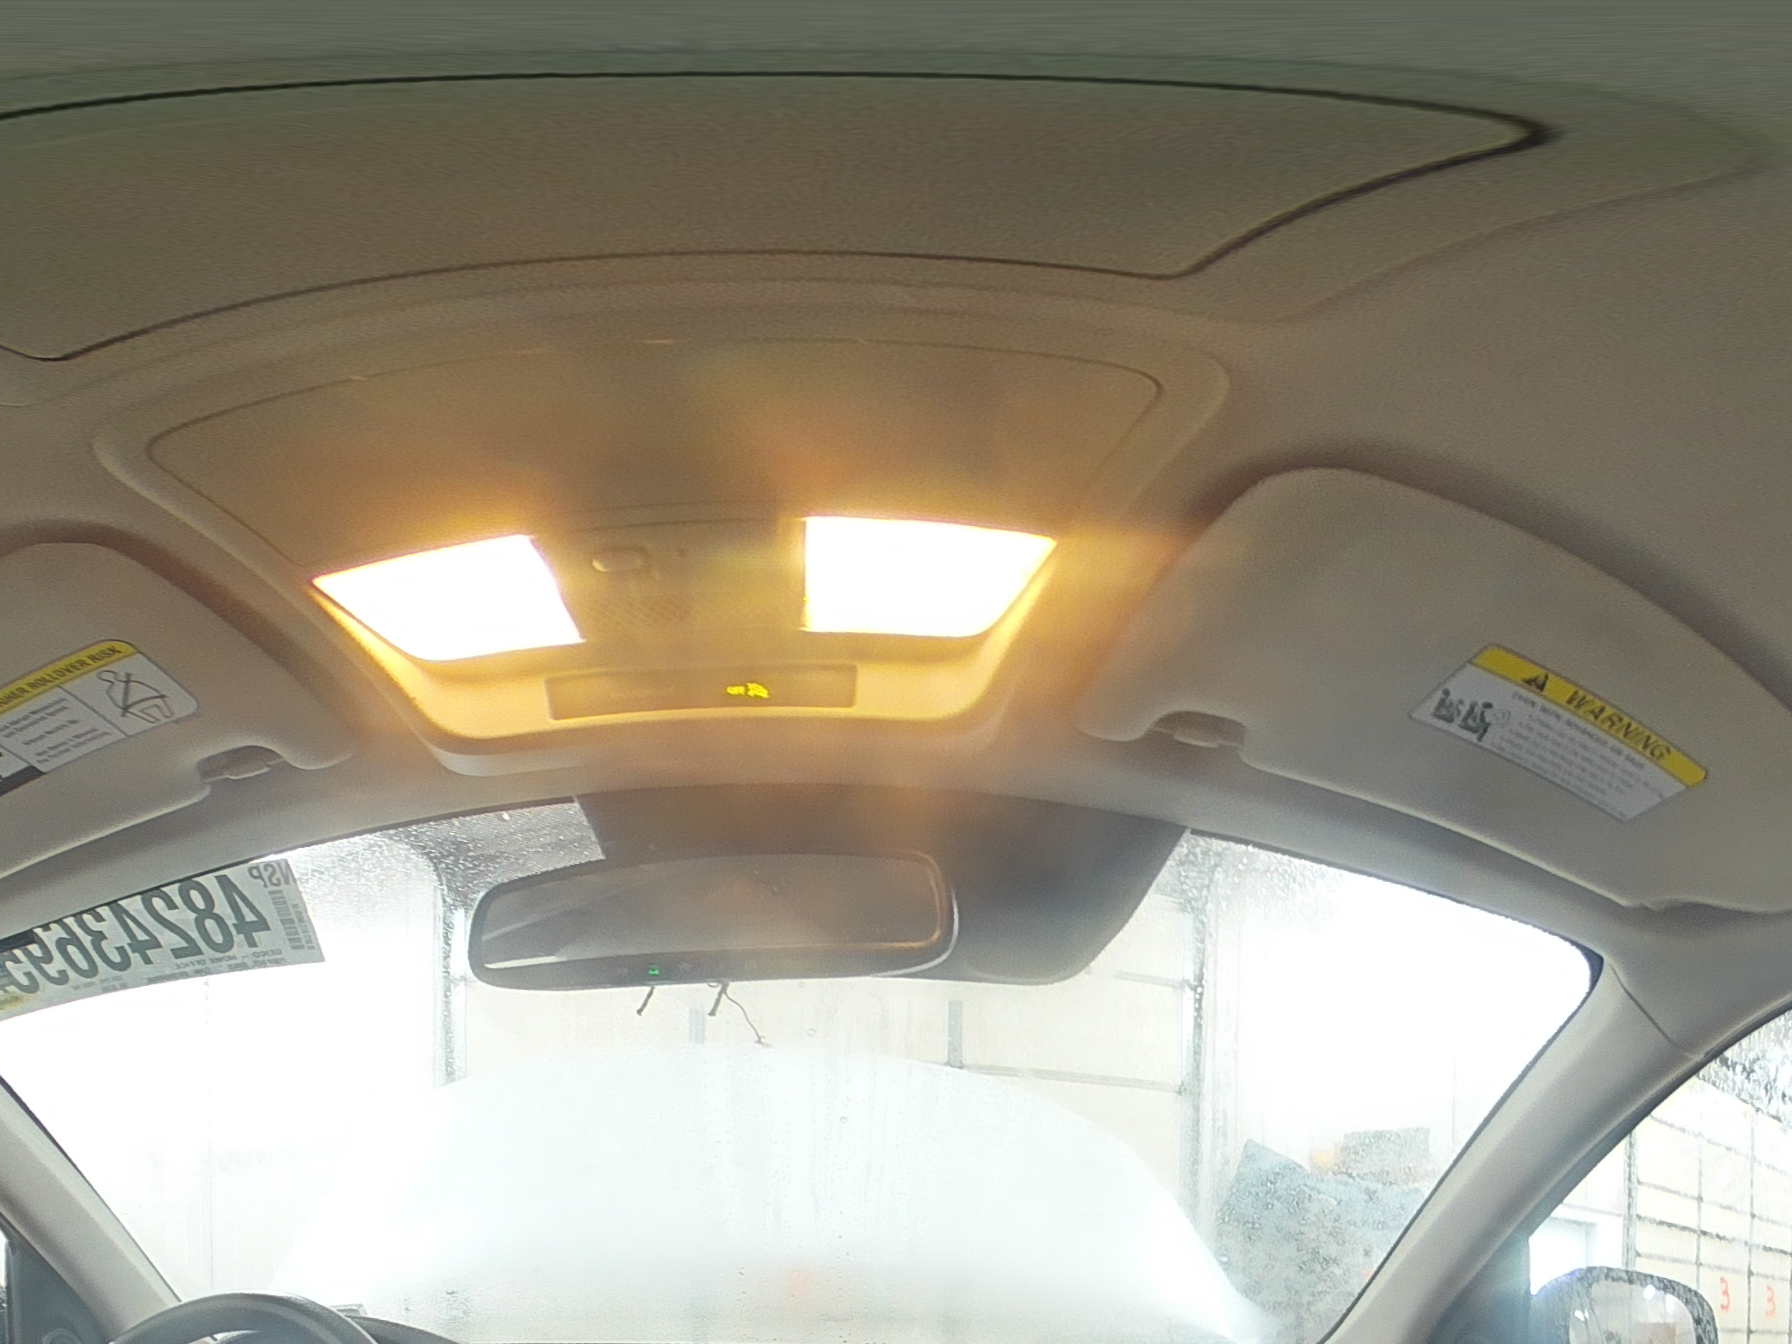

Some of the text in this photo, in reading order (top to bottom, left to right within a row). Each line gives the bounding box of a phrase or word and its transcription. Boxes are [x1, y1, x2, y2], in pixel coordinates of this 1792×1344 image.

[27, 659, 91, 690] ROLLOVER
[87, 645, 123, 665] RISK
[1565, 688, 1671, 761] WARNING
